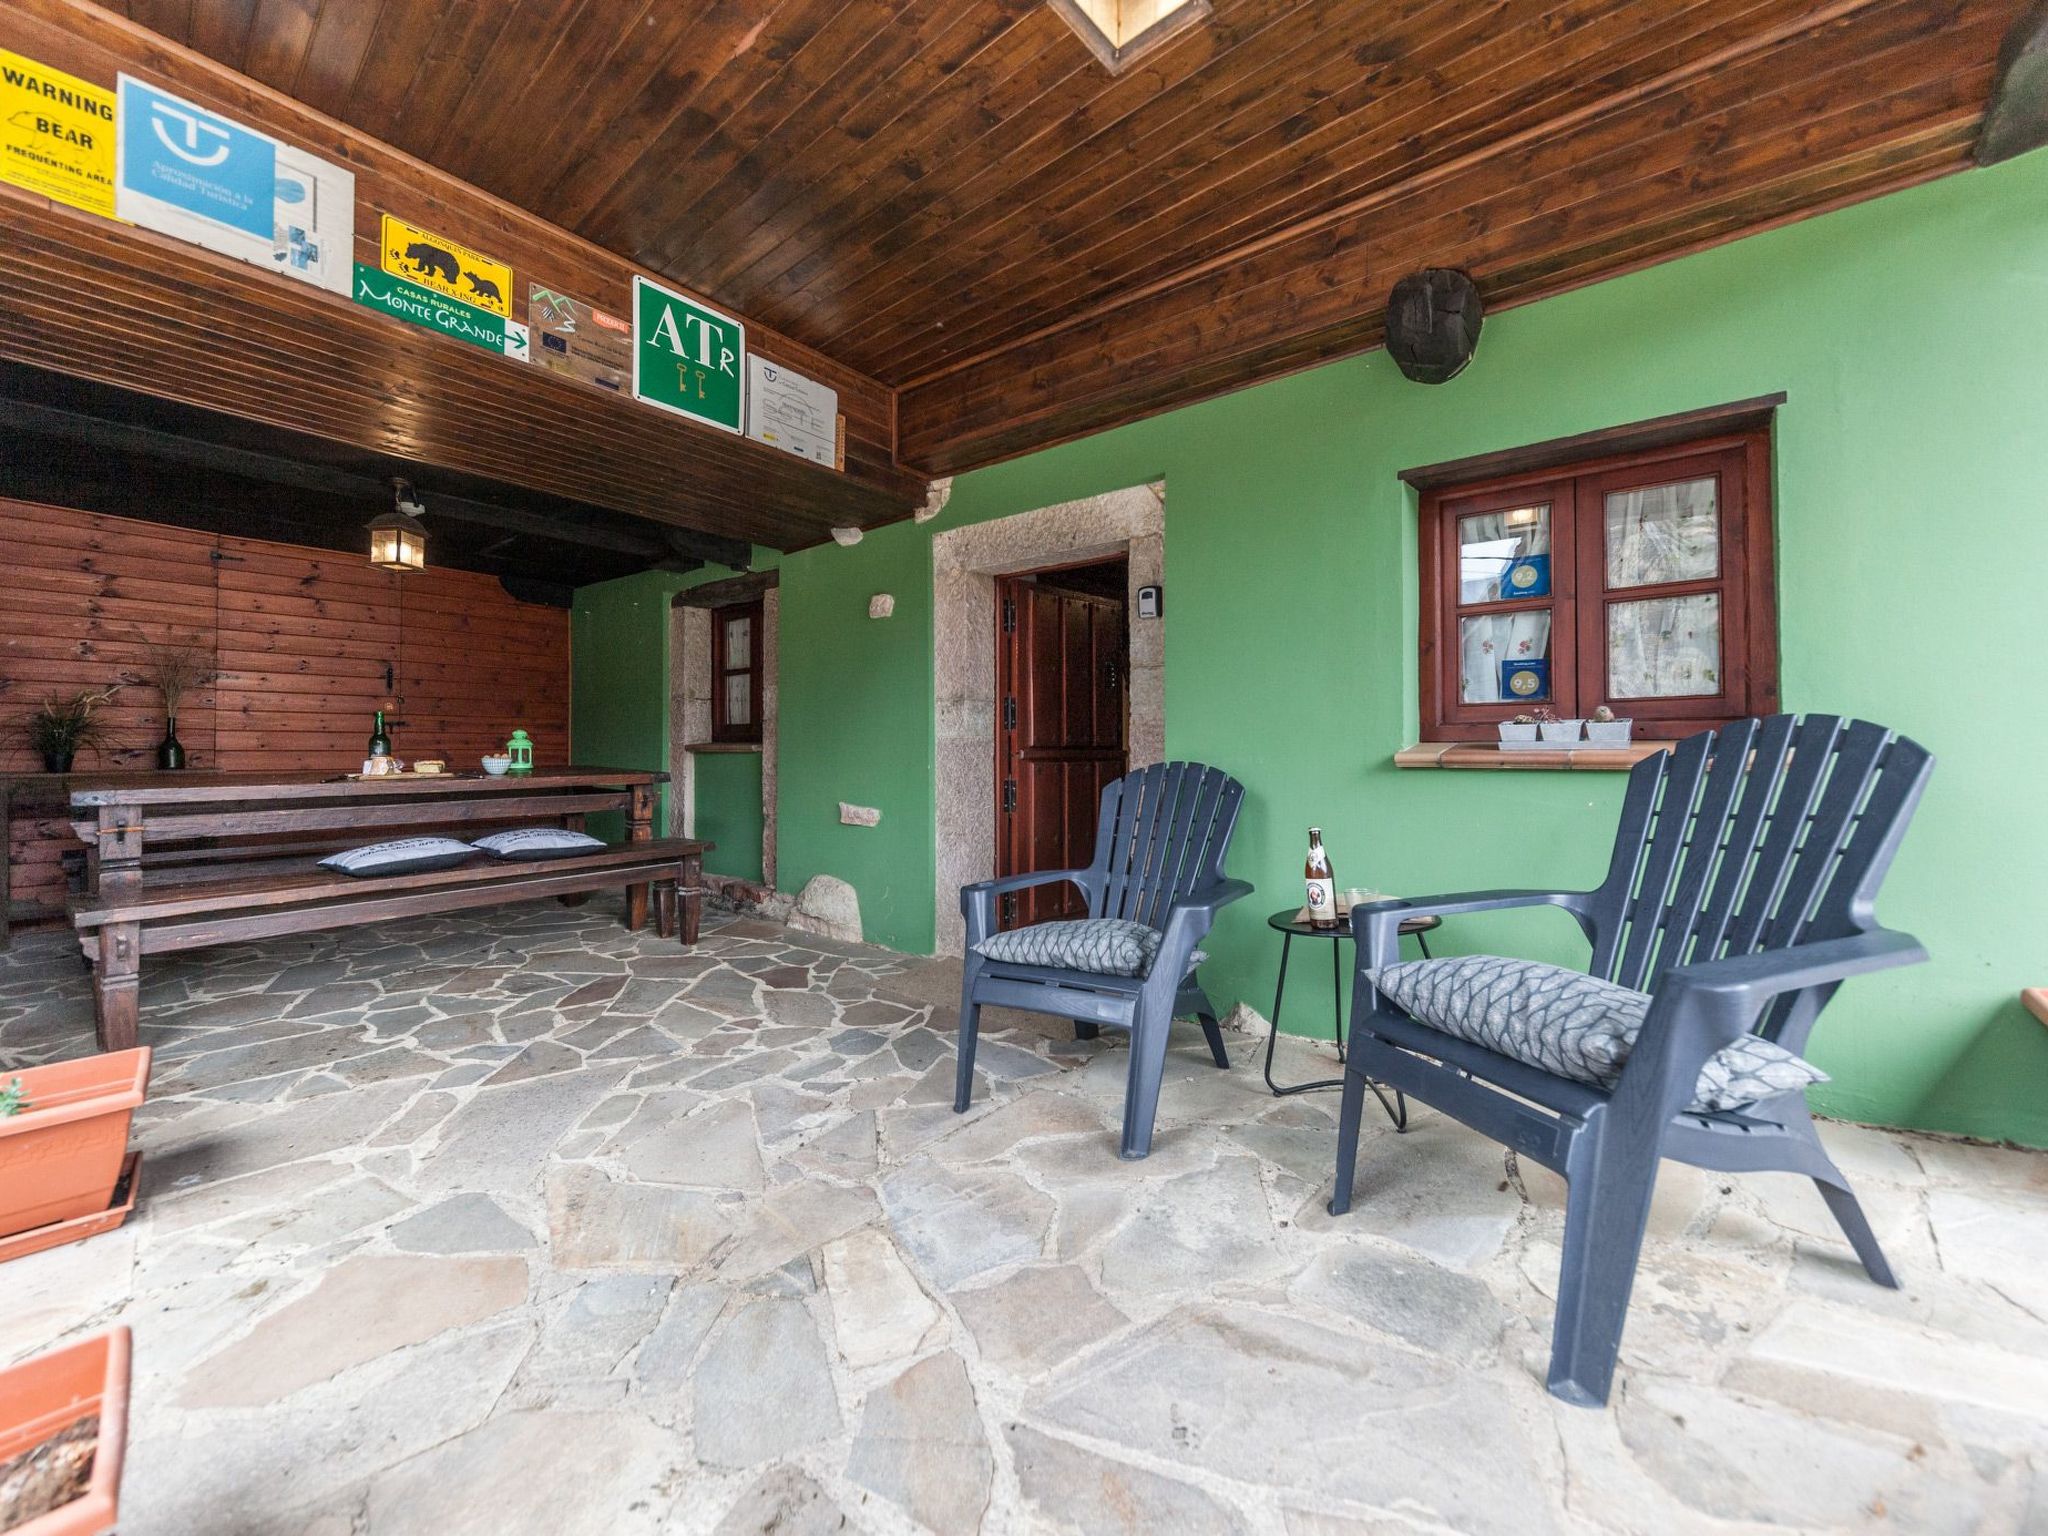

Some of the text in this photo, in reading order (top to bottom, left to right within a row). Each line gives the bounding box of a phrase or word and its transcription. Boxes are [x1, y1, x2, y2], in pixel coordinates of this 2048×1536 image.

[2, 66, 113, 122] WARNING
[36, 117, 93, 150] BEAR
[6, 144, 112, 185] FREQUENTING AREA
[423, 278, 449, 293] BEAR
[360, 280, 503, 347] MONTE GRANDE
[396, 286, 471, 319] CASAS RURALES
[1514, 678, 1535, 690] 9,5
